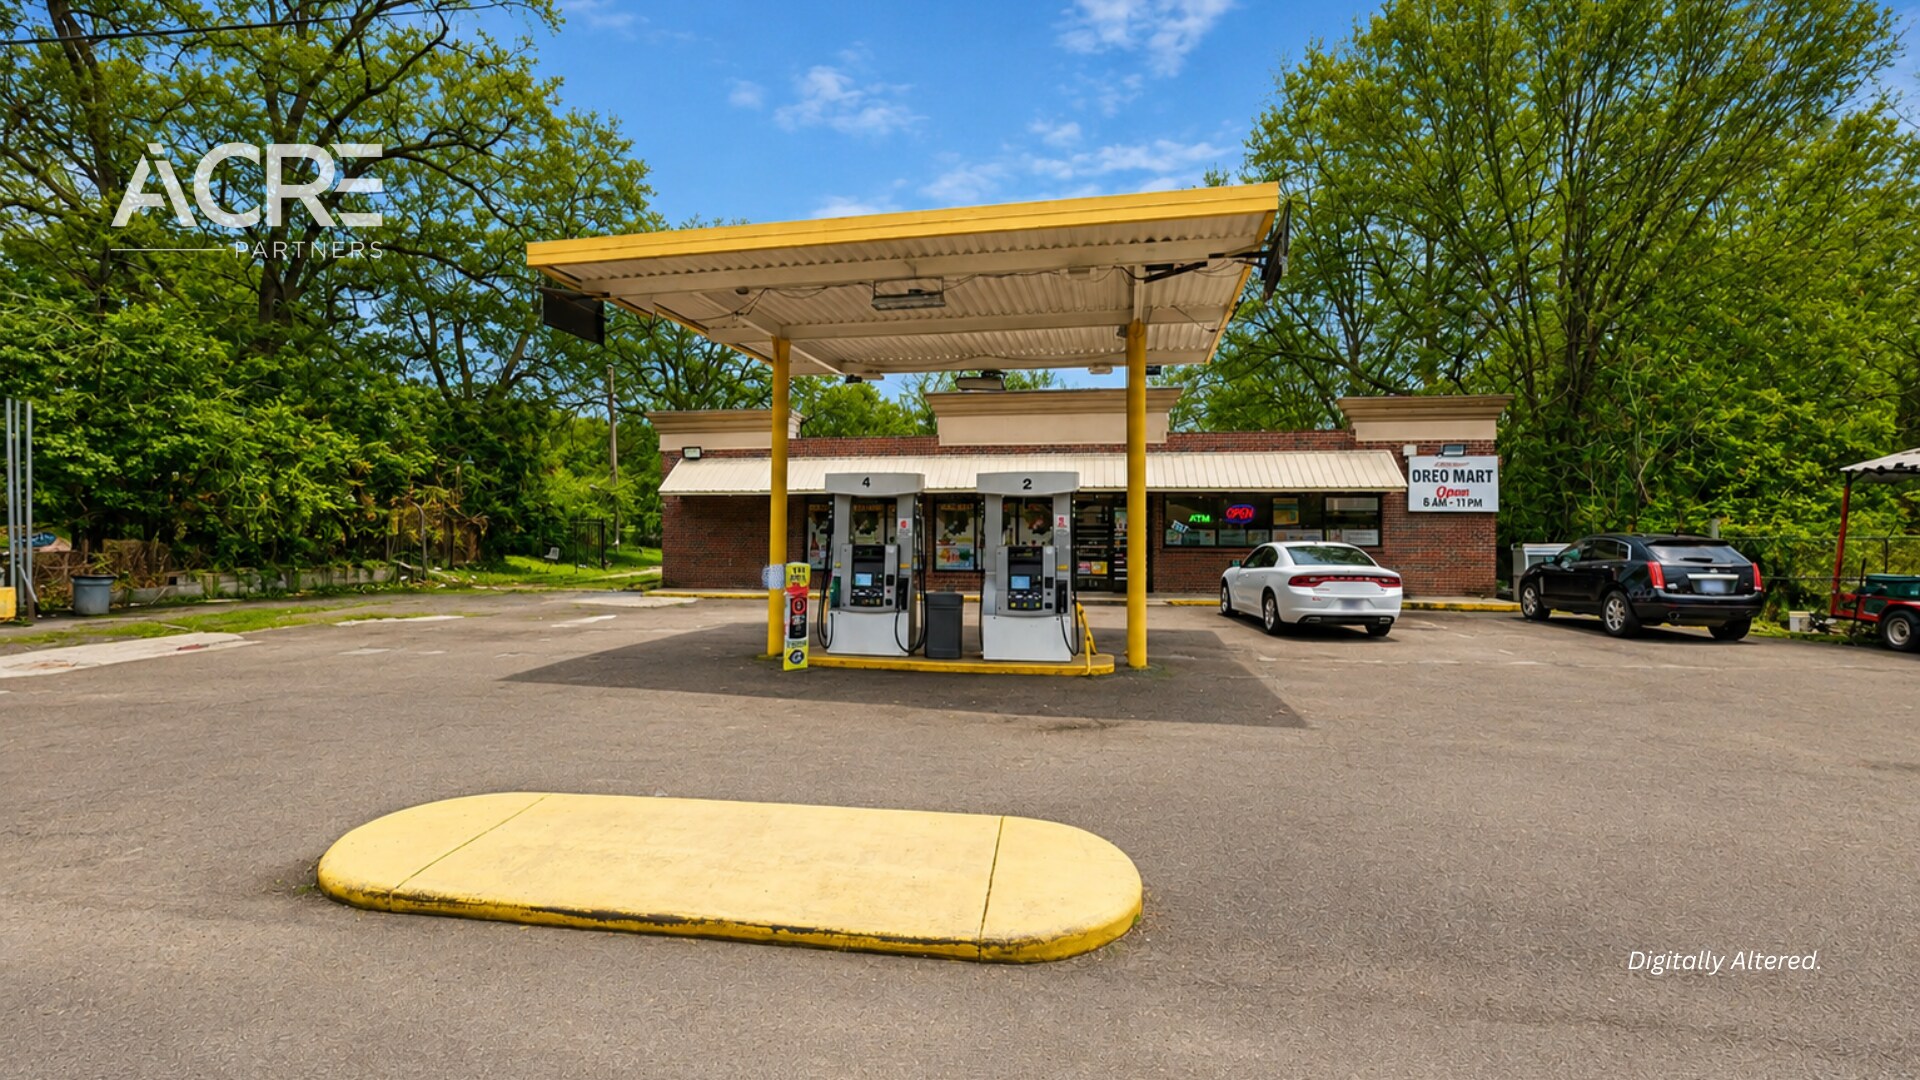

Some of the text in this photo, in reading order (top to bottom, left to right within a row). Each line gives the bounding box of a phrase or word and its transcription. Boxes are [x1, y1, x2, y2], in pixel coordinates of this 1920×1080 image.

[1412, 469, 1493, 483] OREO MART
[862, 477, 871, 488] 4
[1022, 478, 1032, 490] 2
[1189, 514, 1210, 523] ATM
[1226, 507, 1254, 519] OPEN
